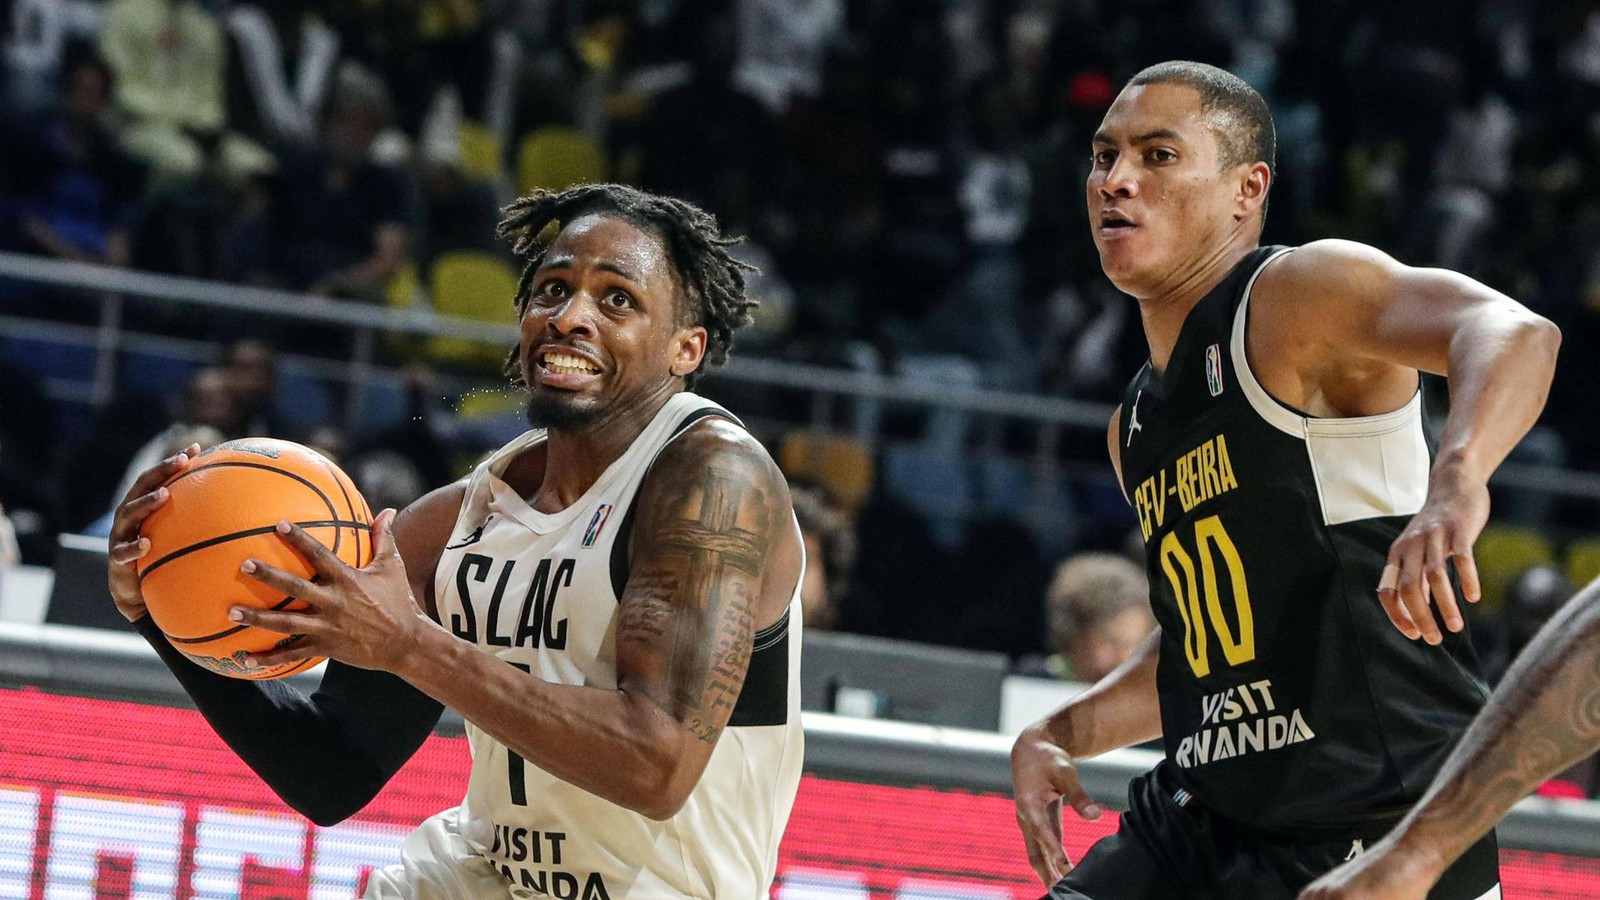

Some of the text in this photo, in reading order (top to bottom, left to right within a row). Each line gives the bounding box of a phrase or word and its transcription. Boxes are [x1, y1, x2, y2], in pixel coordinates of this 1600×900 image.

[1135, 433, 1239, 544] CFV-BEIRA
[451, 552, 576, 651] SLAC
[1160, 514, 1256, 679] 00
[1201, 679, 1276, 726] VISIT
